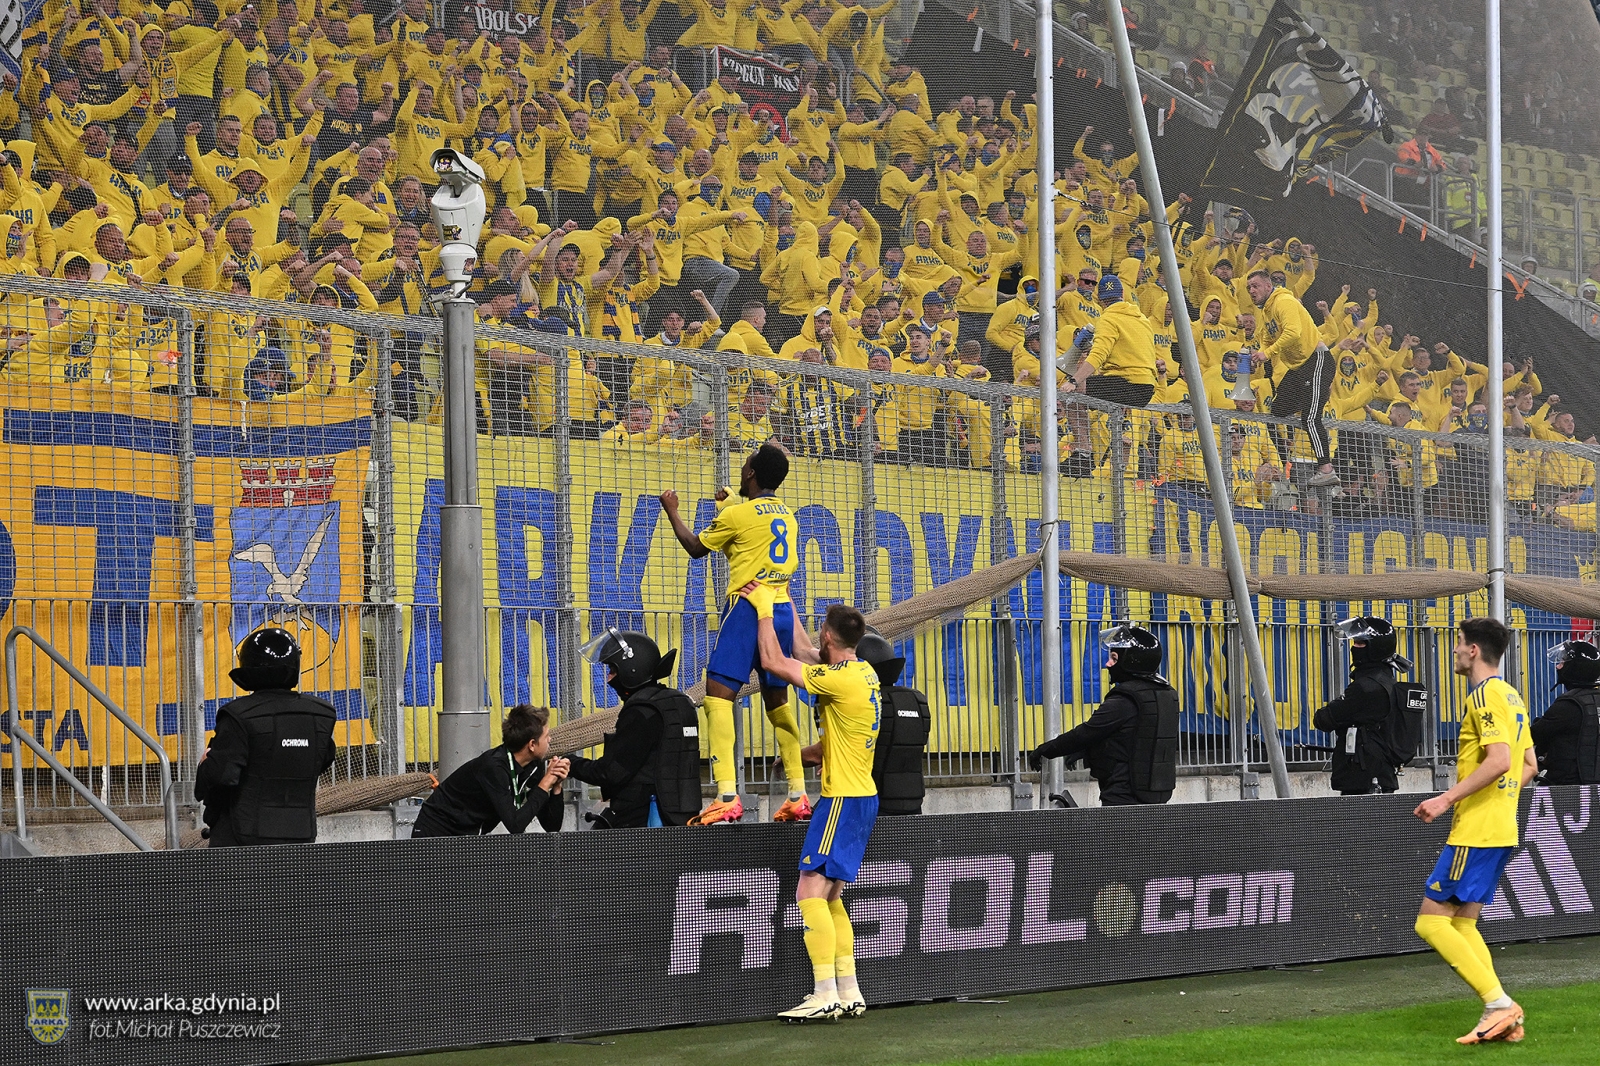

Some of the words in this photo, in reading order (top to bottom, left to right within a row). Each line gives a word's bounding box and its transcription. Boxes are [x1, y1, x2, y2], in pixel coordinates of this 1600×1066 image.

[1203, 329, 1226, 340] ARKA
[769, 518, 789, 564] 8
[1516, 714, 1523, 742] 7
[281, 739, 309, 748] OCHRONA
